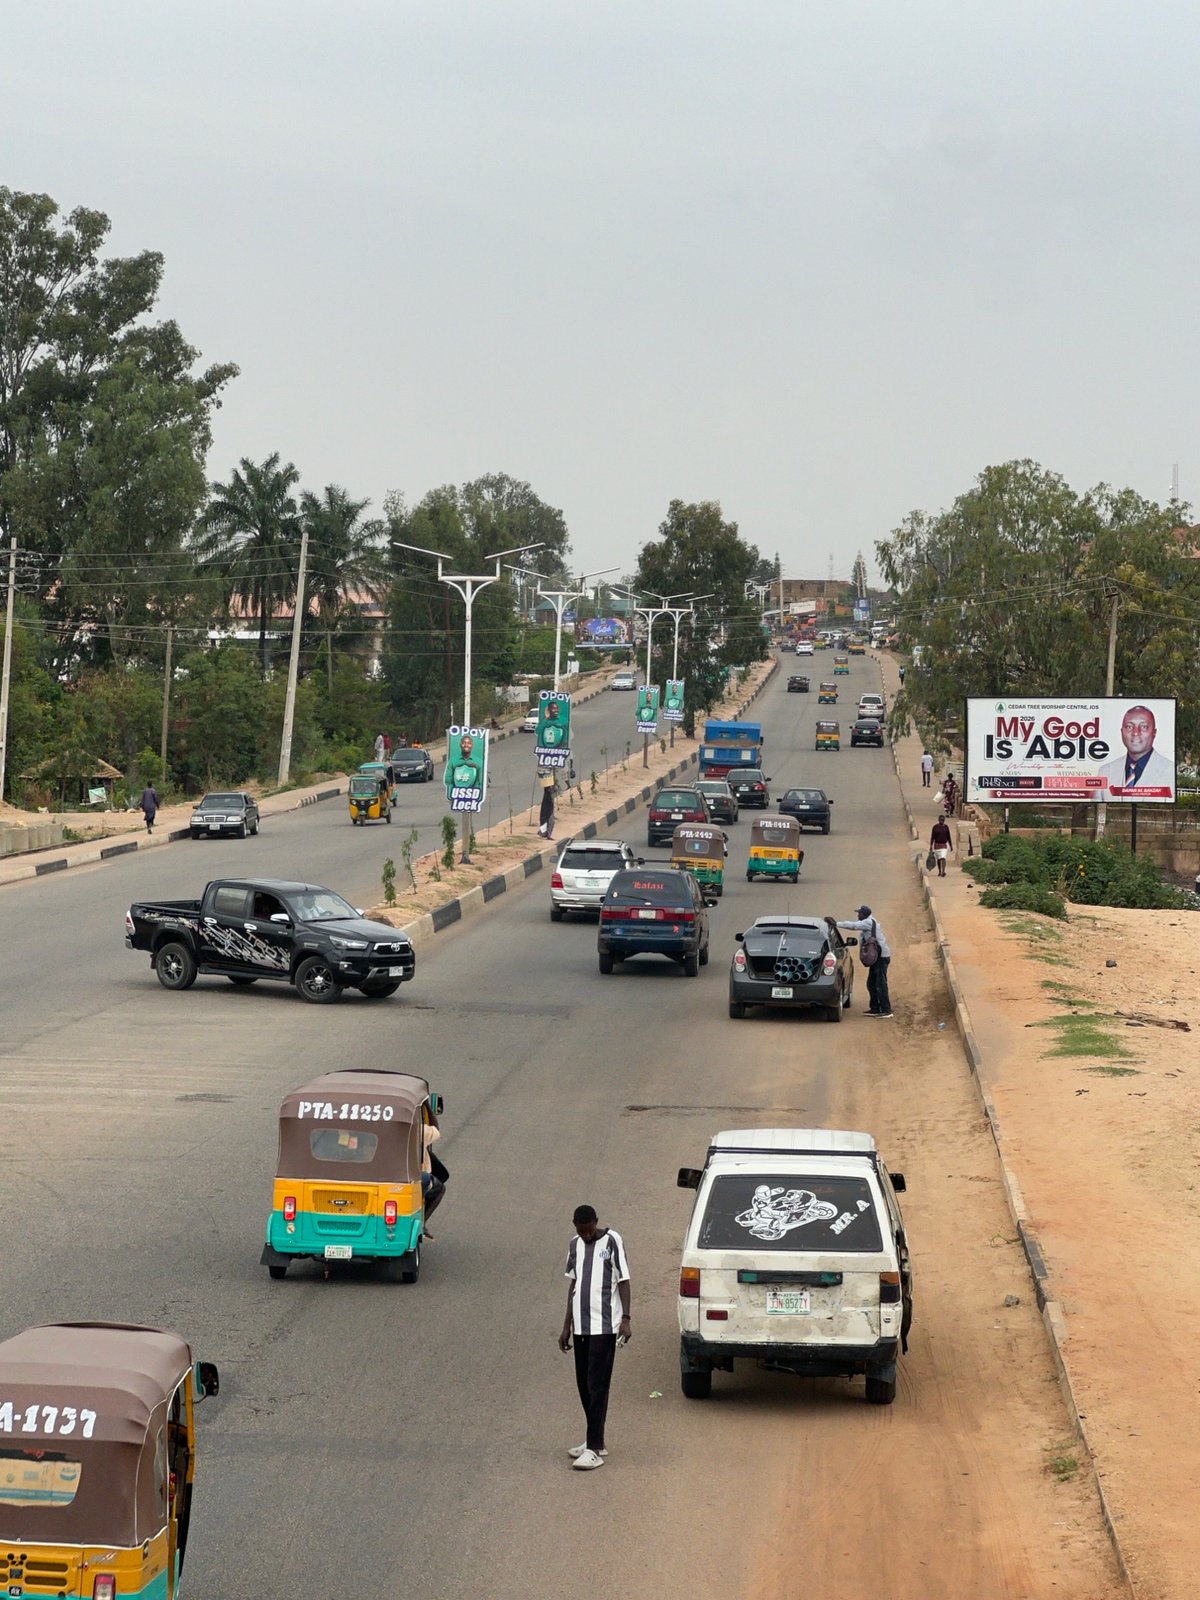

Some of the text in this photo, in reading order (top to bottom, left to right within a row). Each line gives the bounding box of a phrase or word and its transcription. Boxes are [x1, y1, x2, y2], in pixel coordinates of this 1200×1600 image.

[995, 716, 1100, 743] My God
[535, 746, 570, 756] Emergency
[985, 734, 1110, 760] Is Able
[539, 754, 565, 767] Lock
[451, 788, 480, 799] USSD
[452, 799, 479, 811] Lock
[298, 1101, 394, 1121] PTA-11250
[829, 1199, 870, 1235] MR. A
